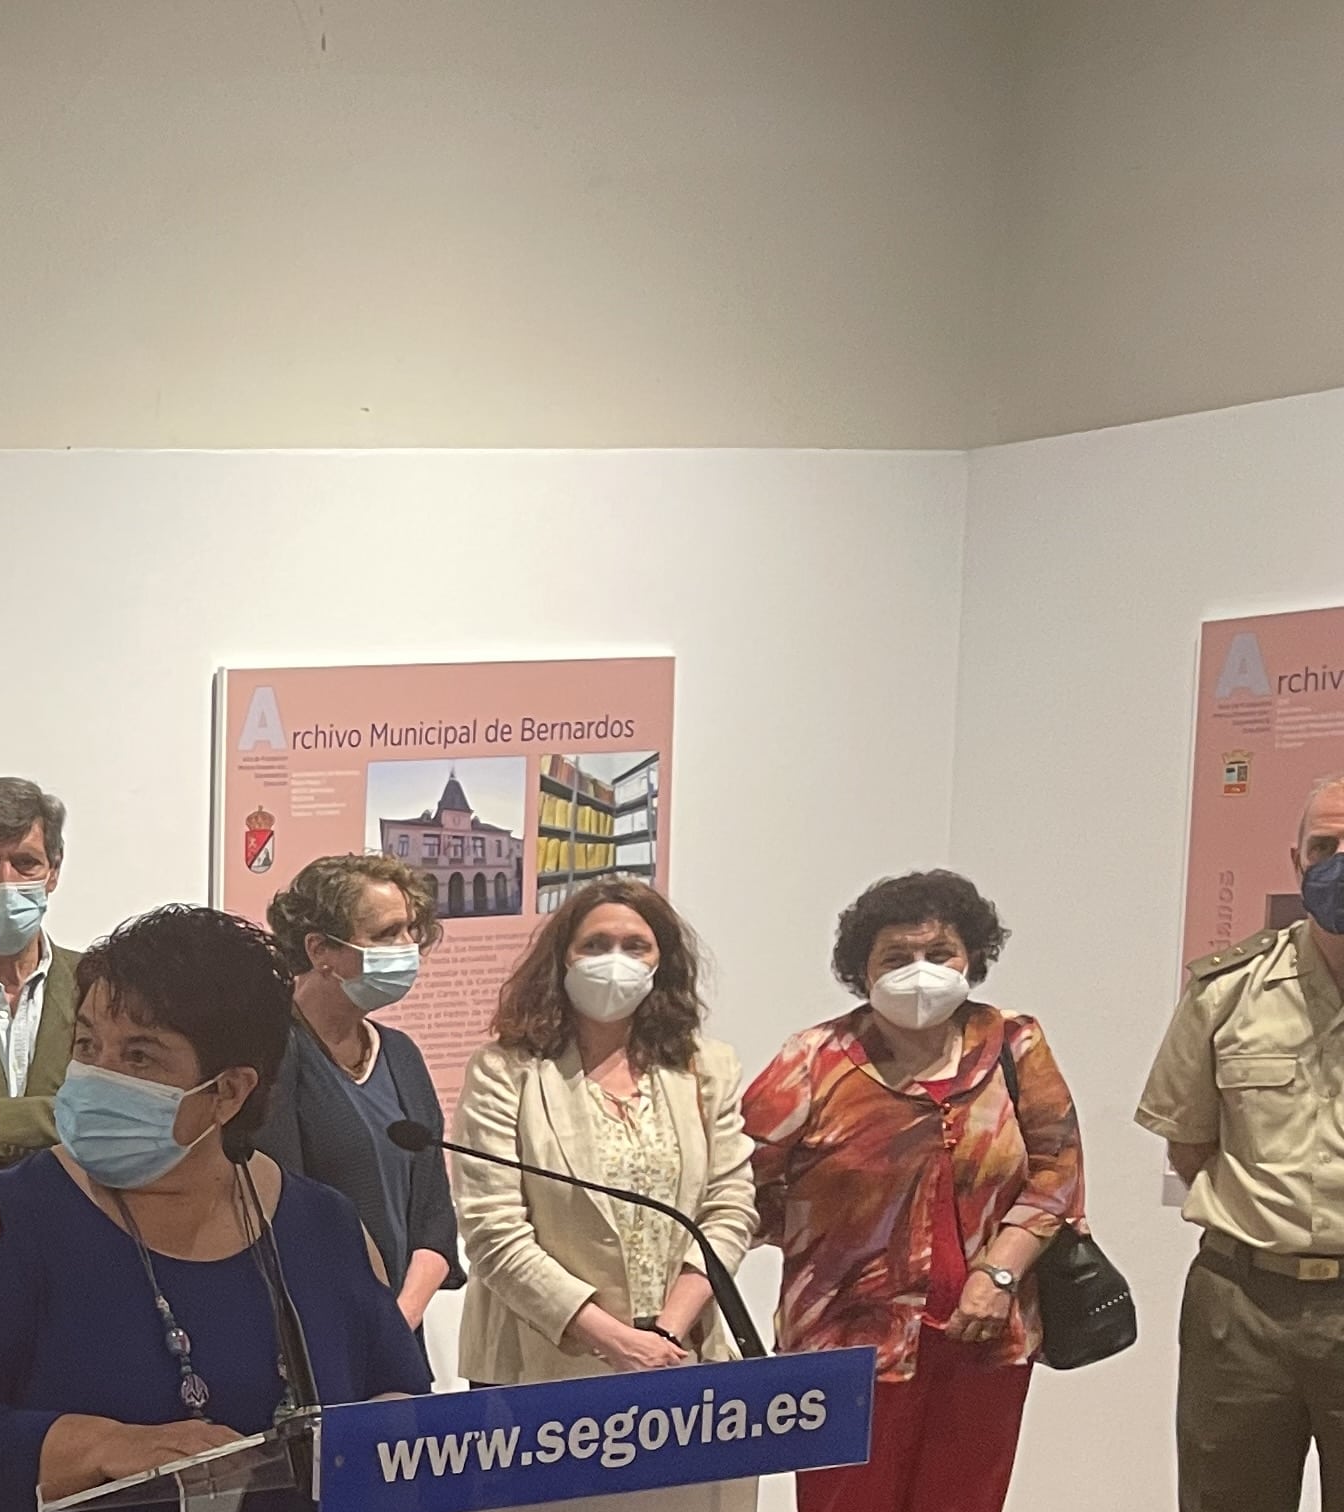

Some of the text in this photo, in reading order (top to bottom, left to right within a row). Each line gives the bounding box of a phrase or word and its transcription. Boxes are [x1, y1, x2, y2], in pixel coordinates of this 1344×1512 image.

[370, 717, 476, 752] Municipal
[484, 717, 513, 744] de
[519, 714, 635, 743] Bernardos
[376, 1386, 829, 1484] www.segovia.es
